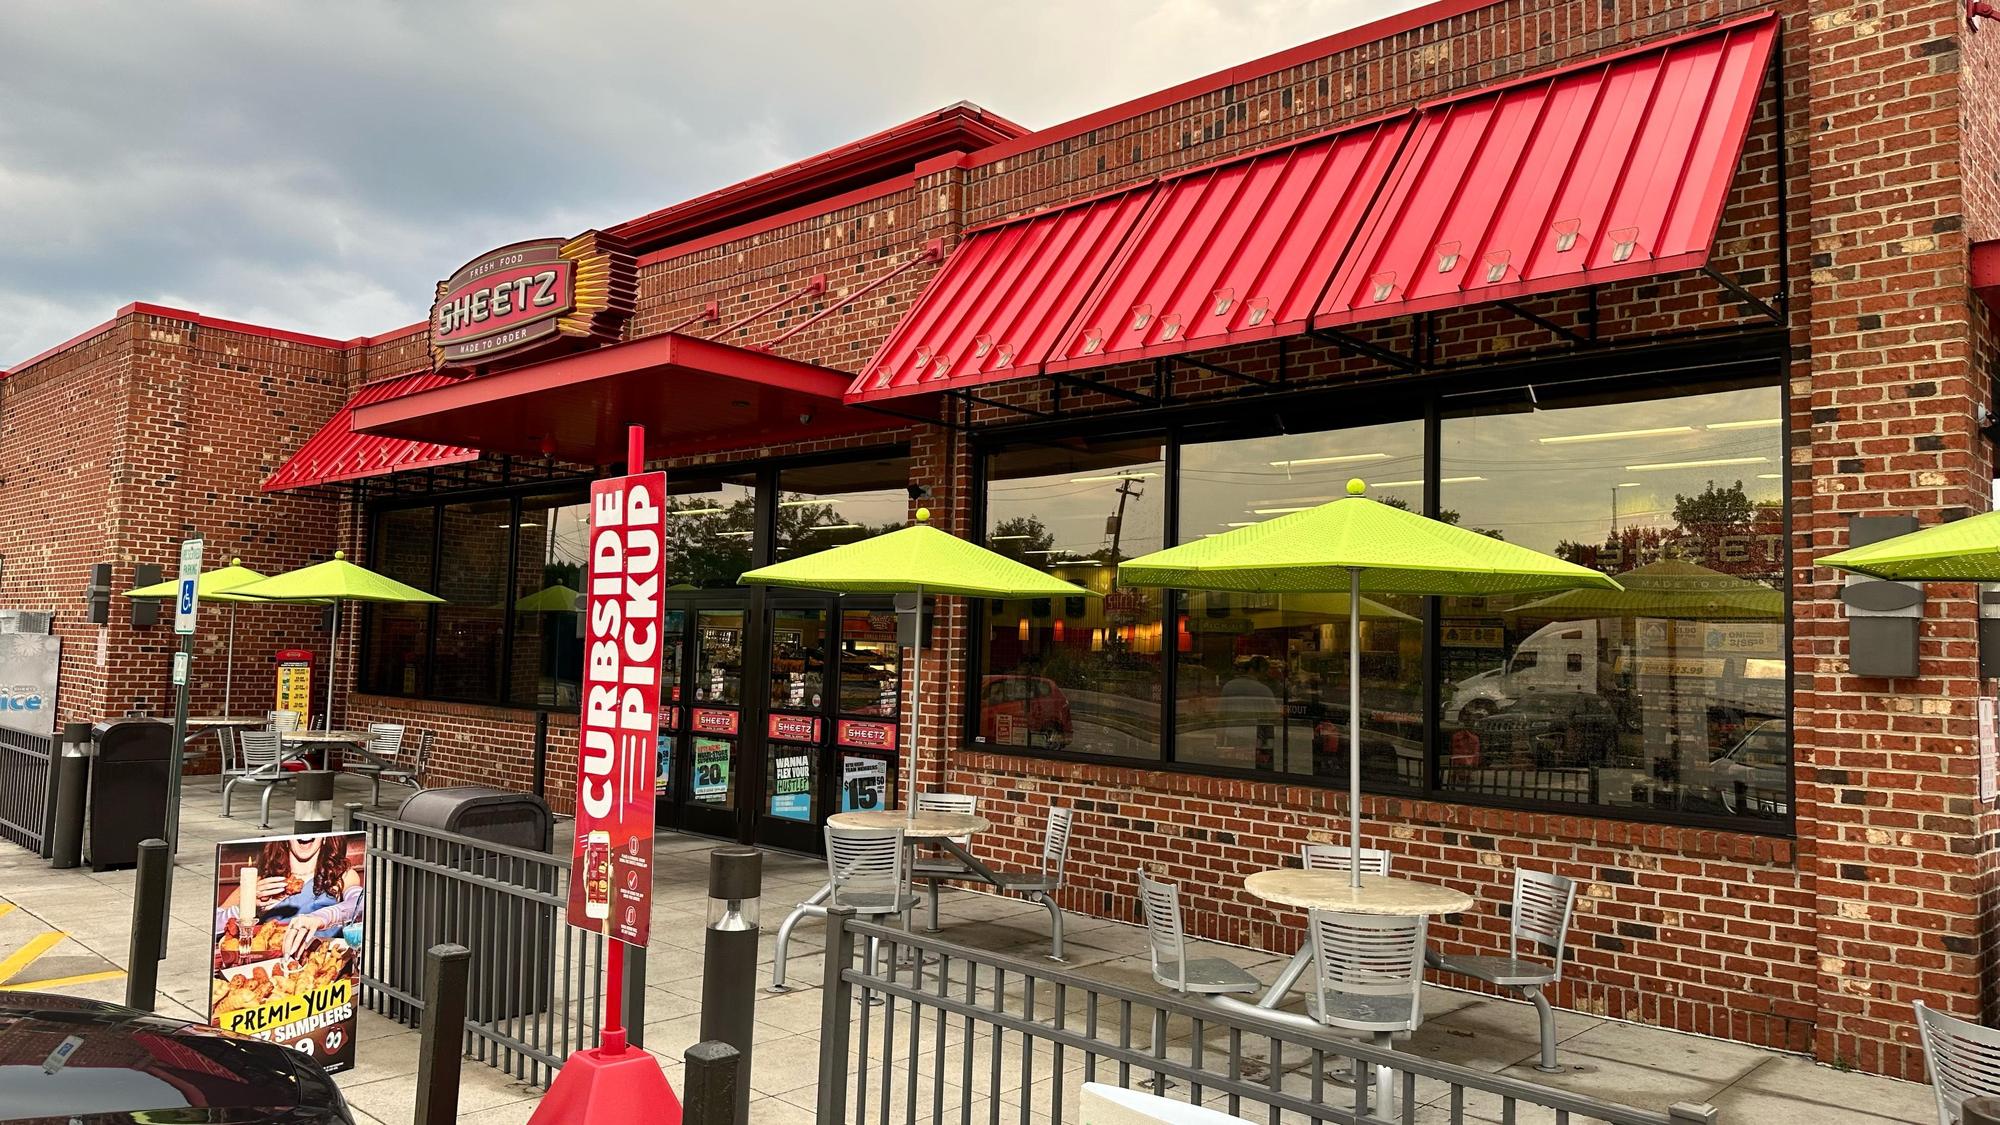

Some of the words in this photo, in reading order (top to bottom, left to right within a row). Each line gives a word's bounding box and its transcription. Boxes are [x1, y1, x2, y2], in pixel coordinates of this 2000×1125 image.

[469, 261, 495, 277] FRESH
[500, 253, 524, 266] FOOD
[440, 271, 556, 334] SHEETZ
[460, 342, 479, 353] MADE
[482, 339, 493, 349] TO
[496, 329, 528, 345] ORDER
[620, 485, 659, 731] PICKUP
[582, 489, 623, 819] CURBSIDE
[0, 688, 42, 710] ice
[701, 716, 731, 725] SHEETZ
[778, 722, 812, 733] SHEETZ
[848, 729, 885, 739] SHEETZ
[776, 756, 809, 768] WANNA
[777, 767, 791, 779] FLEX
[792, 766, 809, 778] YOUR
[778, 778, 808, 792] HUSTLE?
[231, 984, 345, 1032] PREMI-YUM
[275, 1002, 353, 1042] SAMPLERS
